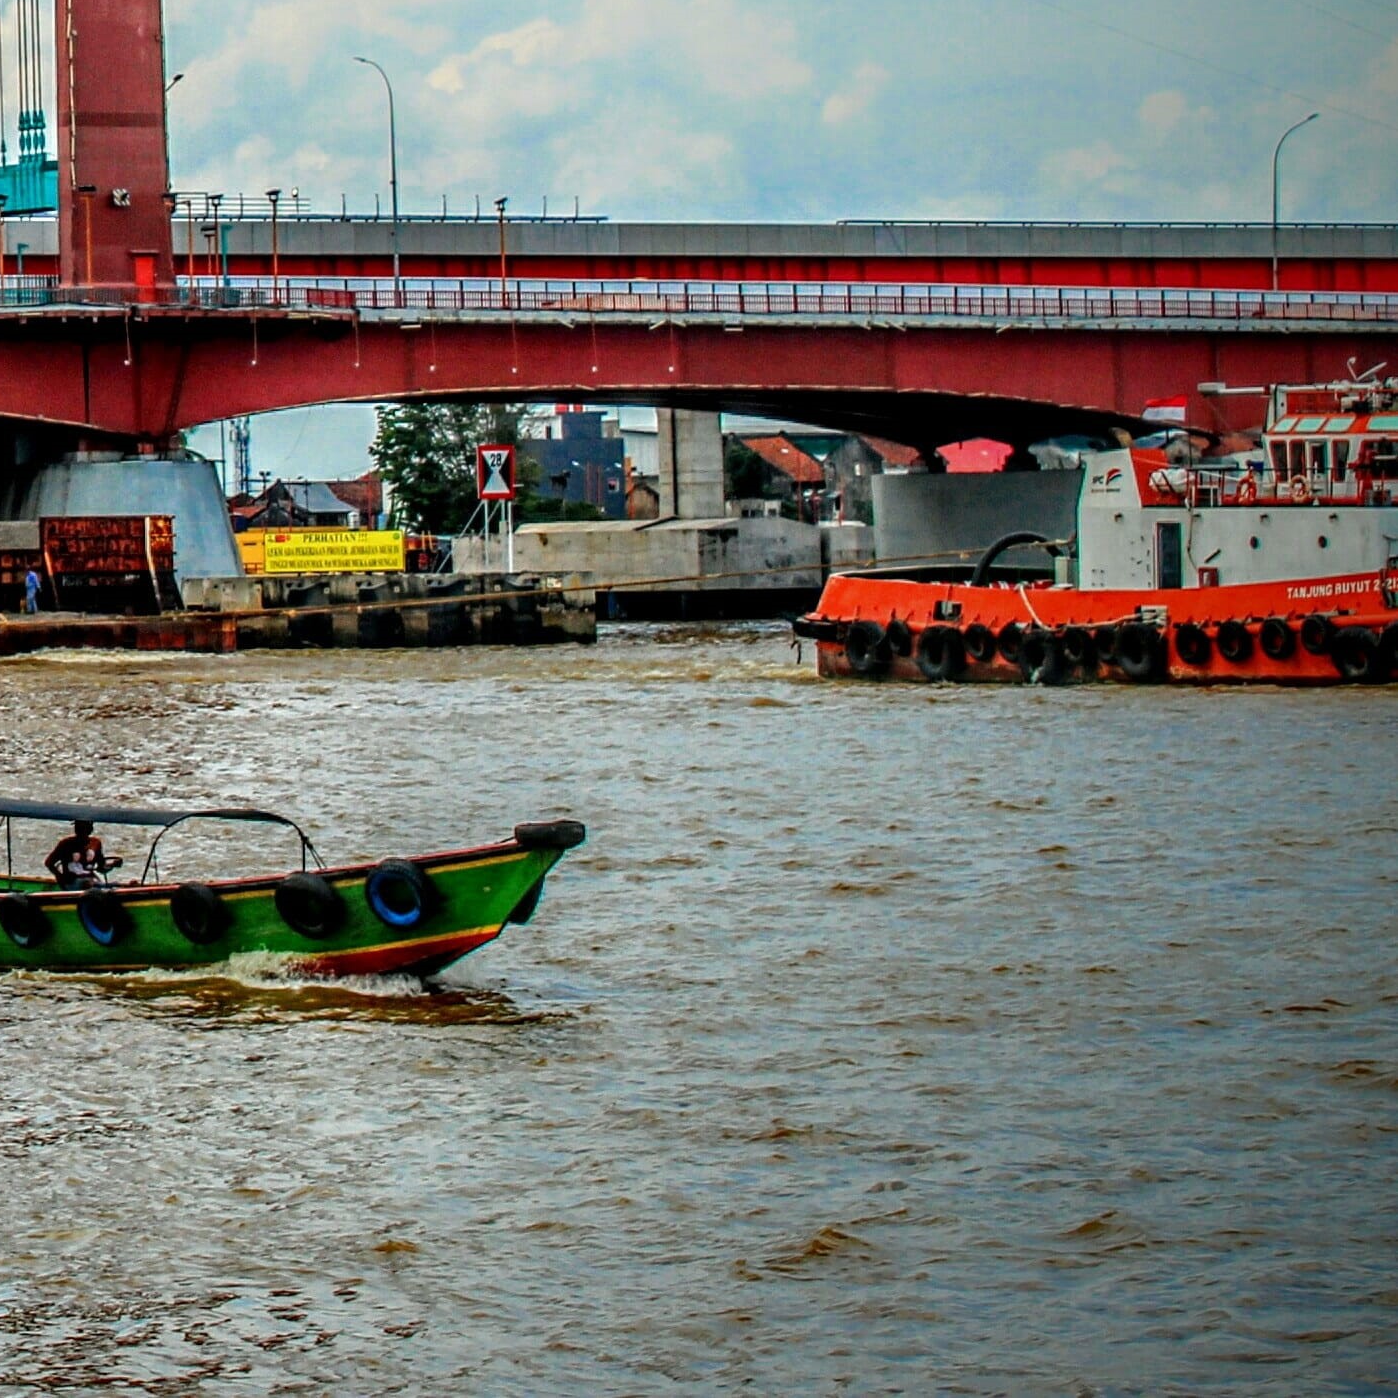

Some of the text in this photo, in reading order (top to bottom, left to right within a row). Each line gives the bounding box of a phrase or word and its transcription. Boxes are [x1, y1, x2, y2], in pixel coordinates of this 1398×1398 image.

[490, 453, 502, 467] 28
[302, 533, 356, 543] PERHATIAN
[1287, 584, 1333, 599] TANJUNG
[1334, 580, 1371, 595] BUYUT
